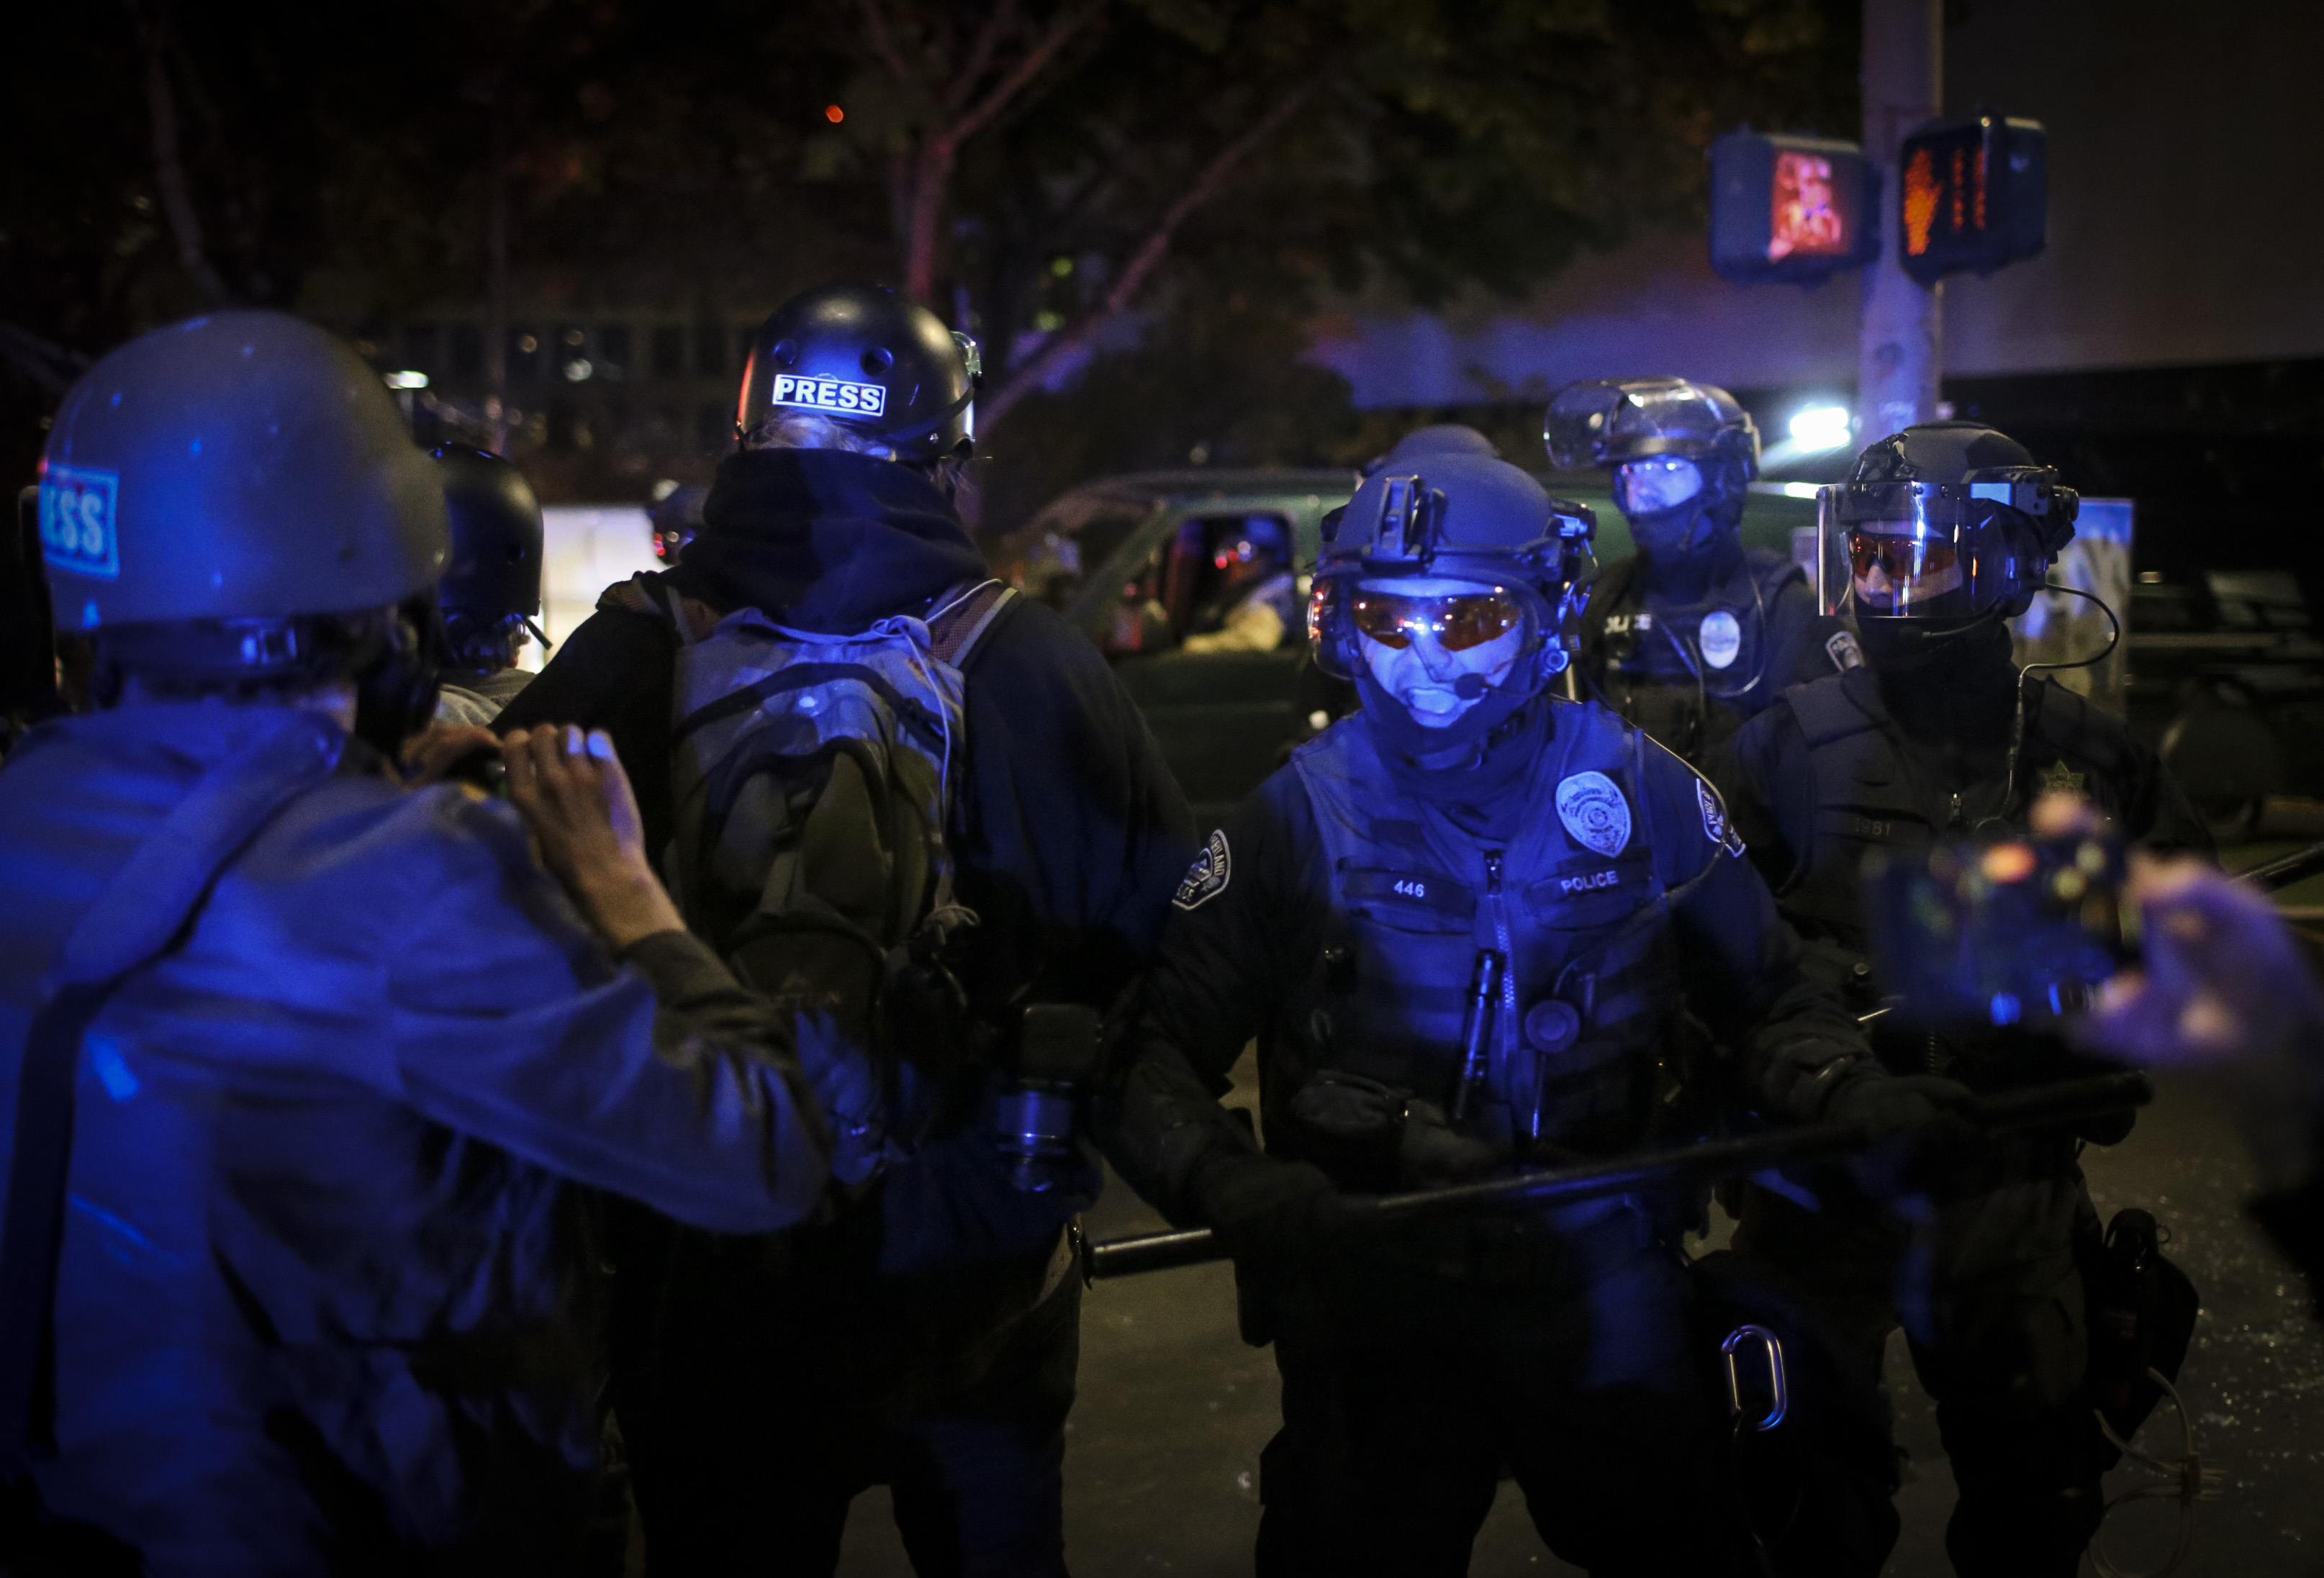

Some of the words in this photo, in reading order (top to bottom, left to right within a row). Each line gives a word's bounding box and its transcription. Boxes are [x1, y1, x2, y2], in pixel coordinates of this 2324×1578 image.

[777, 378, 881, 412] PRESS
[1393, 879, 1425, 898] 446
[1560, 870, 1619, 893] POLICE
